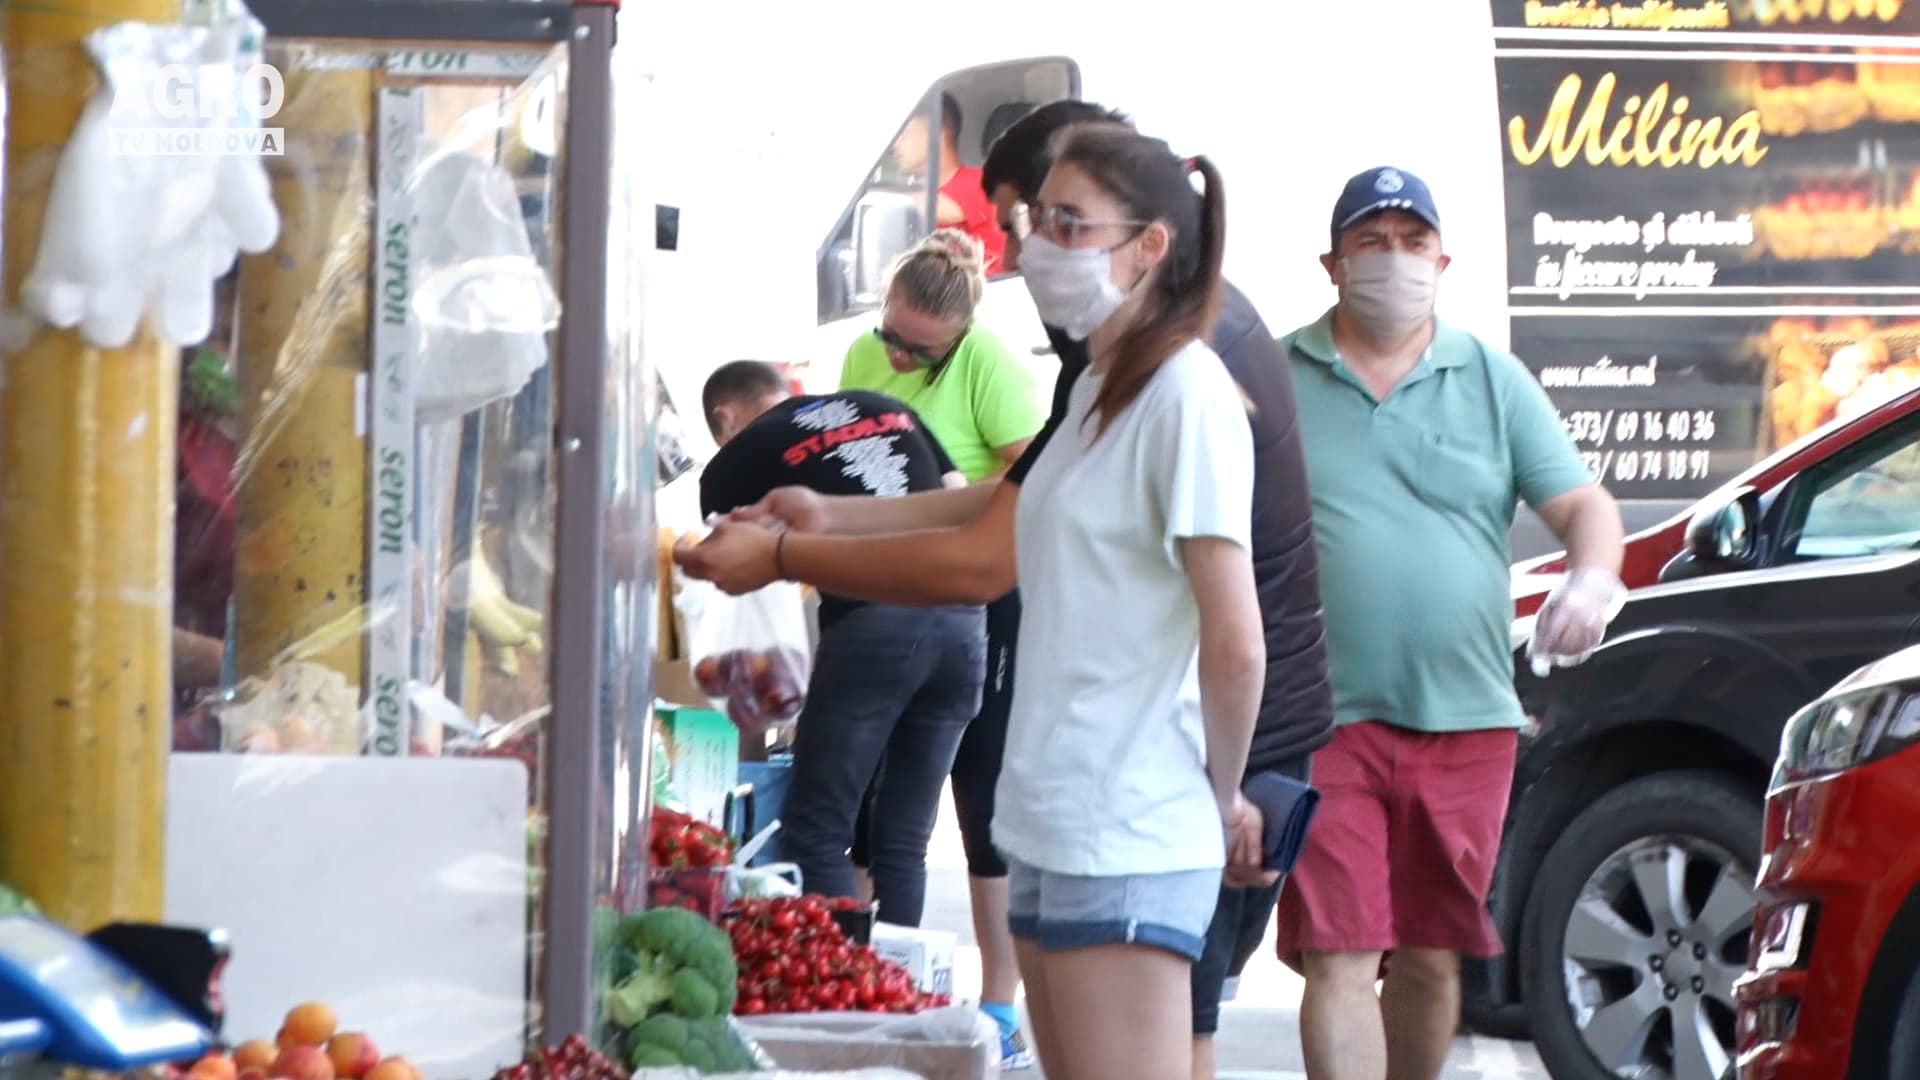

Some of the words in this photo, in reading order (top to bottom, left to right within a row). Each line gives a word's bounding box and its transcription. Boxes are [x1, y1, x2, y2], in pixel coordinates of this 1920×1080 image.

[1508, 72, 1768, 168] Milina
[383, 219, 408, 325] seron
[1666, 411, 1691, 441] 40
[379, 446, 404, 553] seron
